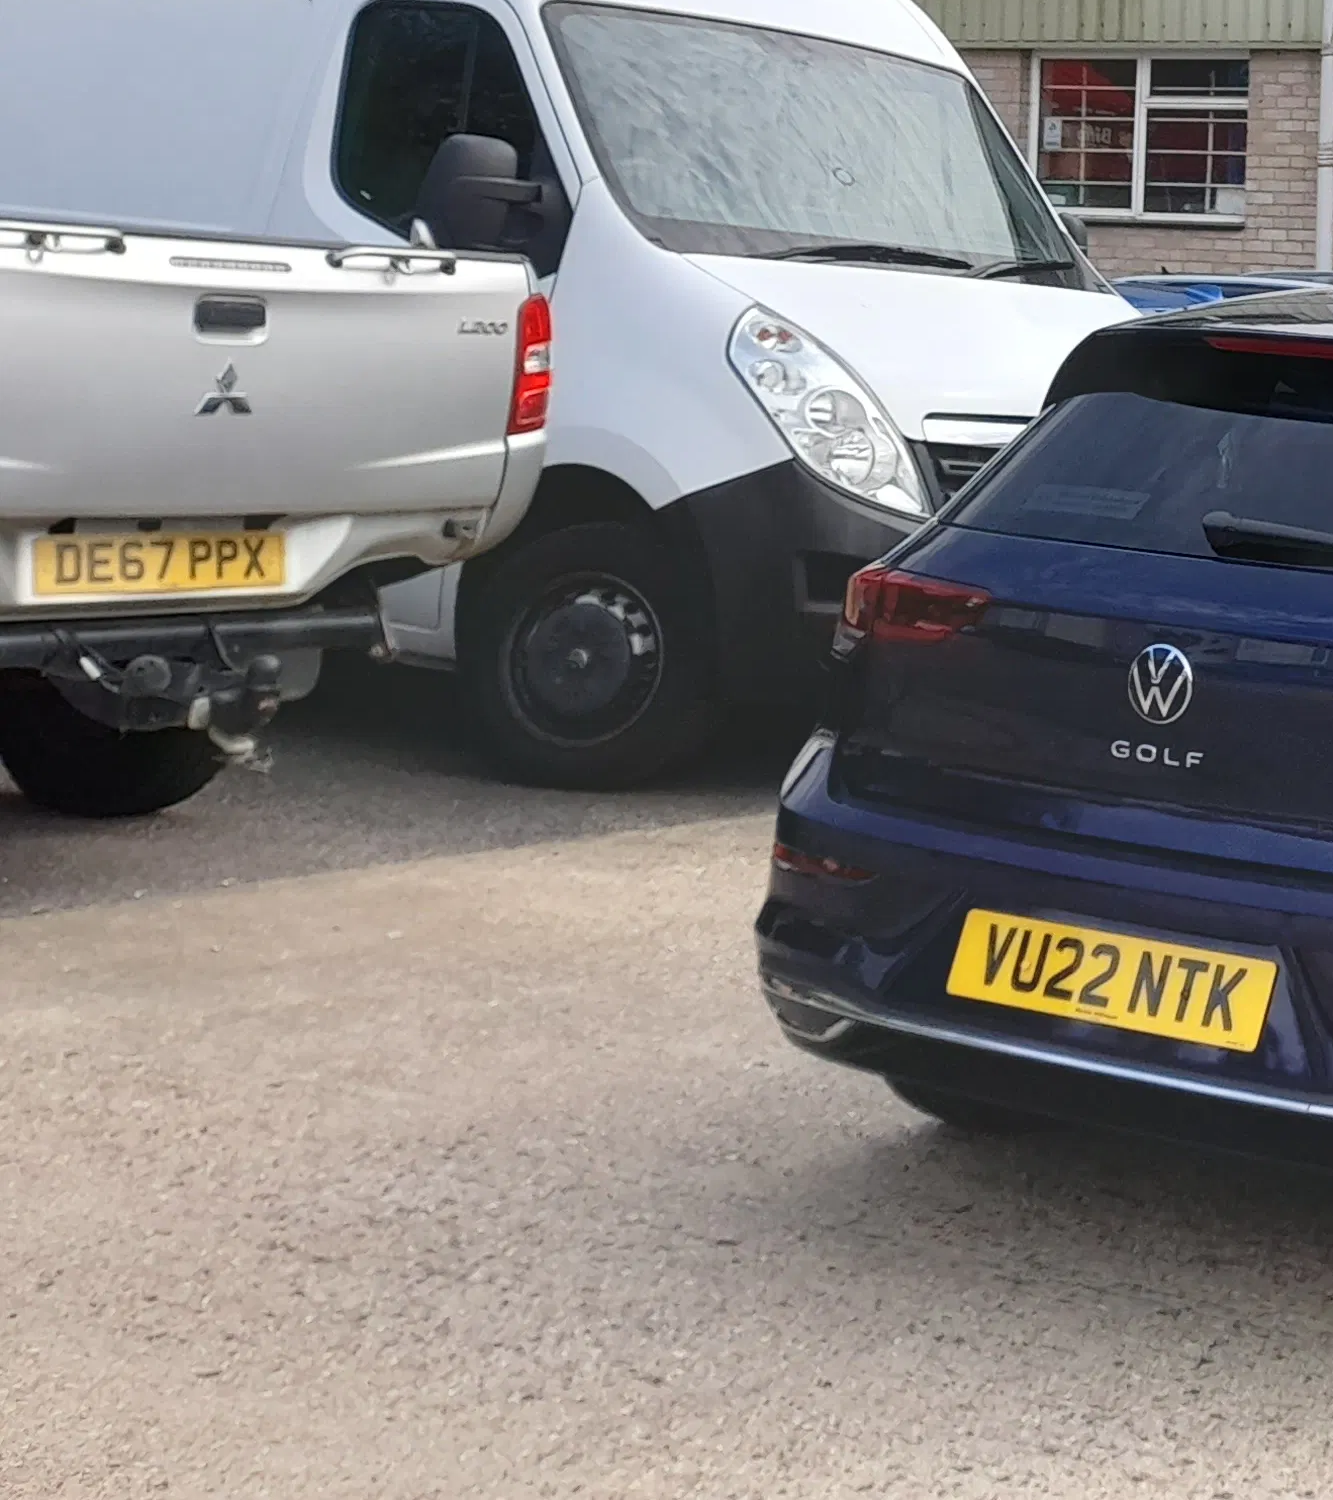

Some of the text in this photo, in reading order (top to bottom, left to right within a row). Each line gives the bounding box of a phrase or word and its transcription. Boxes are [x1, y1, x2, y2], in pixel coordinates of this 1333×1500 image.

[54, 537, 265, 584] DE67 PPX
[1110, 739, 1204, 768] GOLF
[982, 923, 1248, 1032] VU22 NTK
